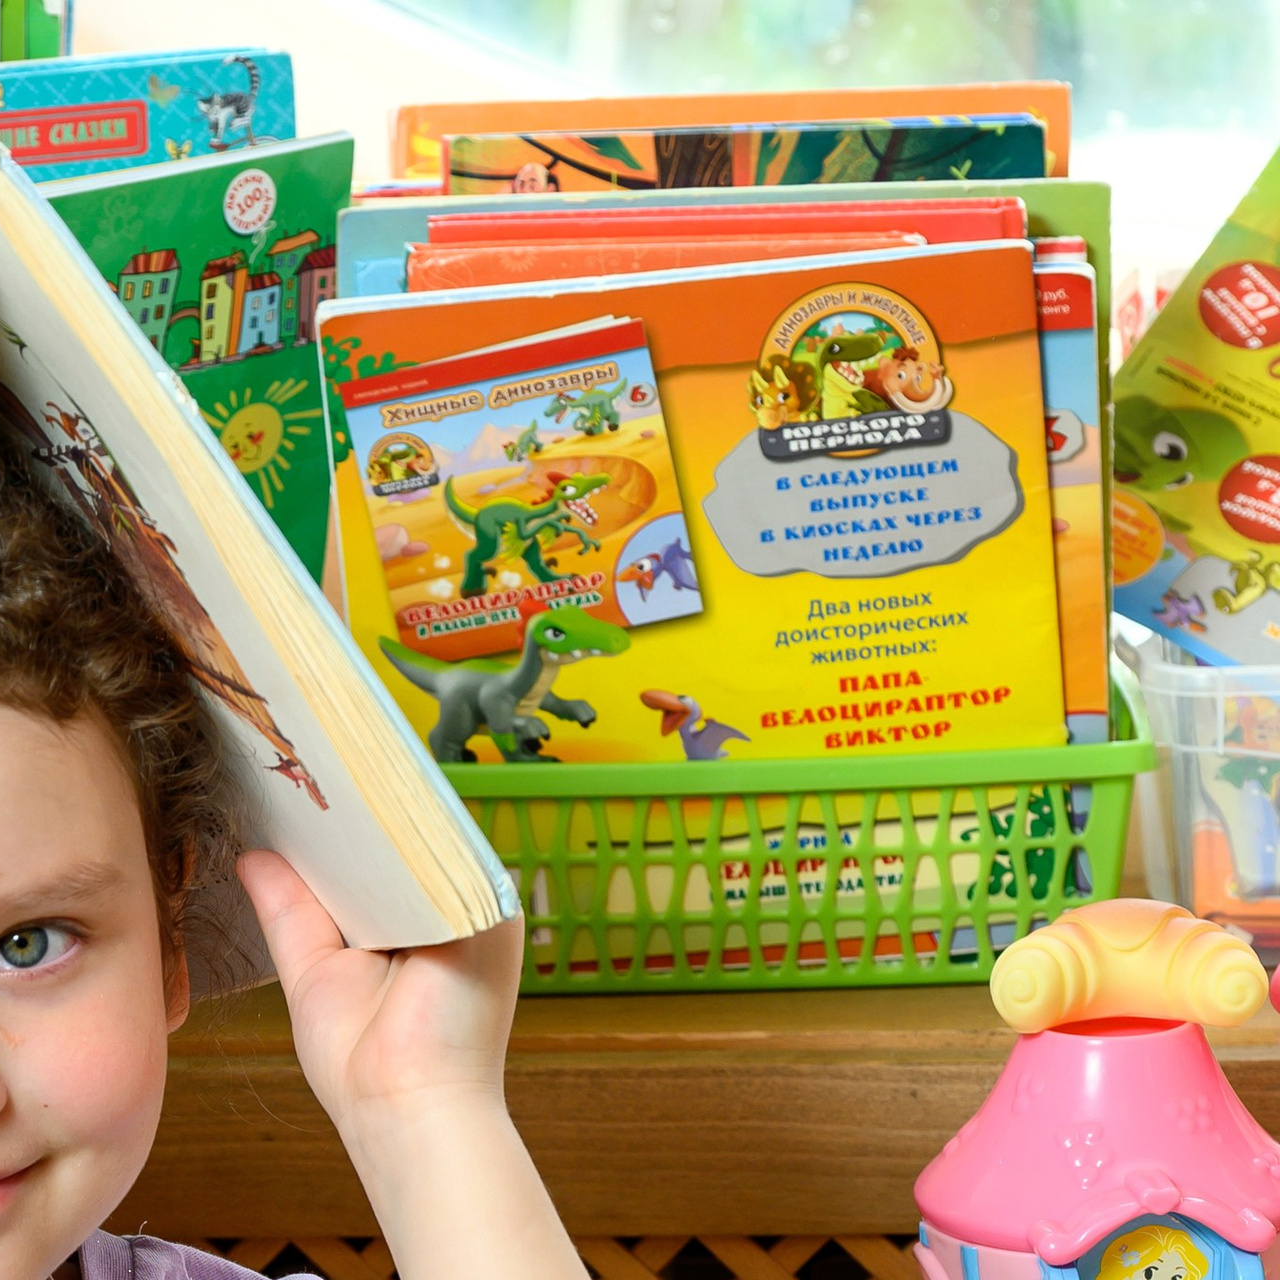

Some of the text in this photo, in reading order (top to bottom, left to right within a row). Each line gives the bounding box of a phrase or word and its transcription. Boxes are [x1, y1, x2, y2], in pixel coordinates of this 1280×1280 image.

[49, 118, 128, 145] СКАЗКИ
[237, 187, 263, 215] 100
[775, 291, 926, 349] ДИНОЗАВРЫ И ЖИВОТНЫЕ
[629, 384, 649, 403] 6
[386, 394, 480, 423] Хищные
[782, 414, 926, 440] ЮРСКОГО
[789, 427, 922, 452] ПЕРИОДА
[775, 459, 959, 491] В СЛЕДУЮЩЕМ
[810, 487, 929, 512] ВЫПУСКЕ
[760, 506, 983, 543] В КИОСКАХ ЧЕРЕЗ
[823, 539, 923, 562] НЕДЕЛЮ
[408, 573, 604, 622] ВЕЛОЦИРАПТОР
[807, 592, 933, 621] Два новых
[774, 611, 969, 648] доисторических
[811, 639, 937, 665] животных:
[760, 686, 1012, 728] ВЕЛОЦИРАПТОР
[824, 721, 952, 749] ВИКТОР
